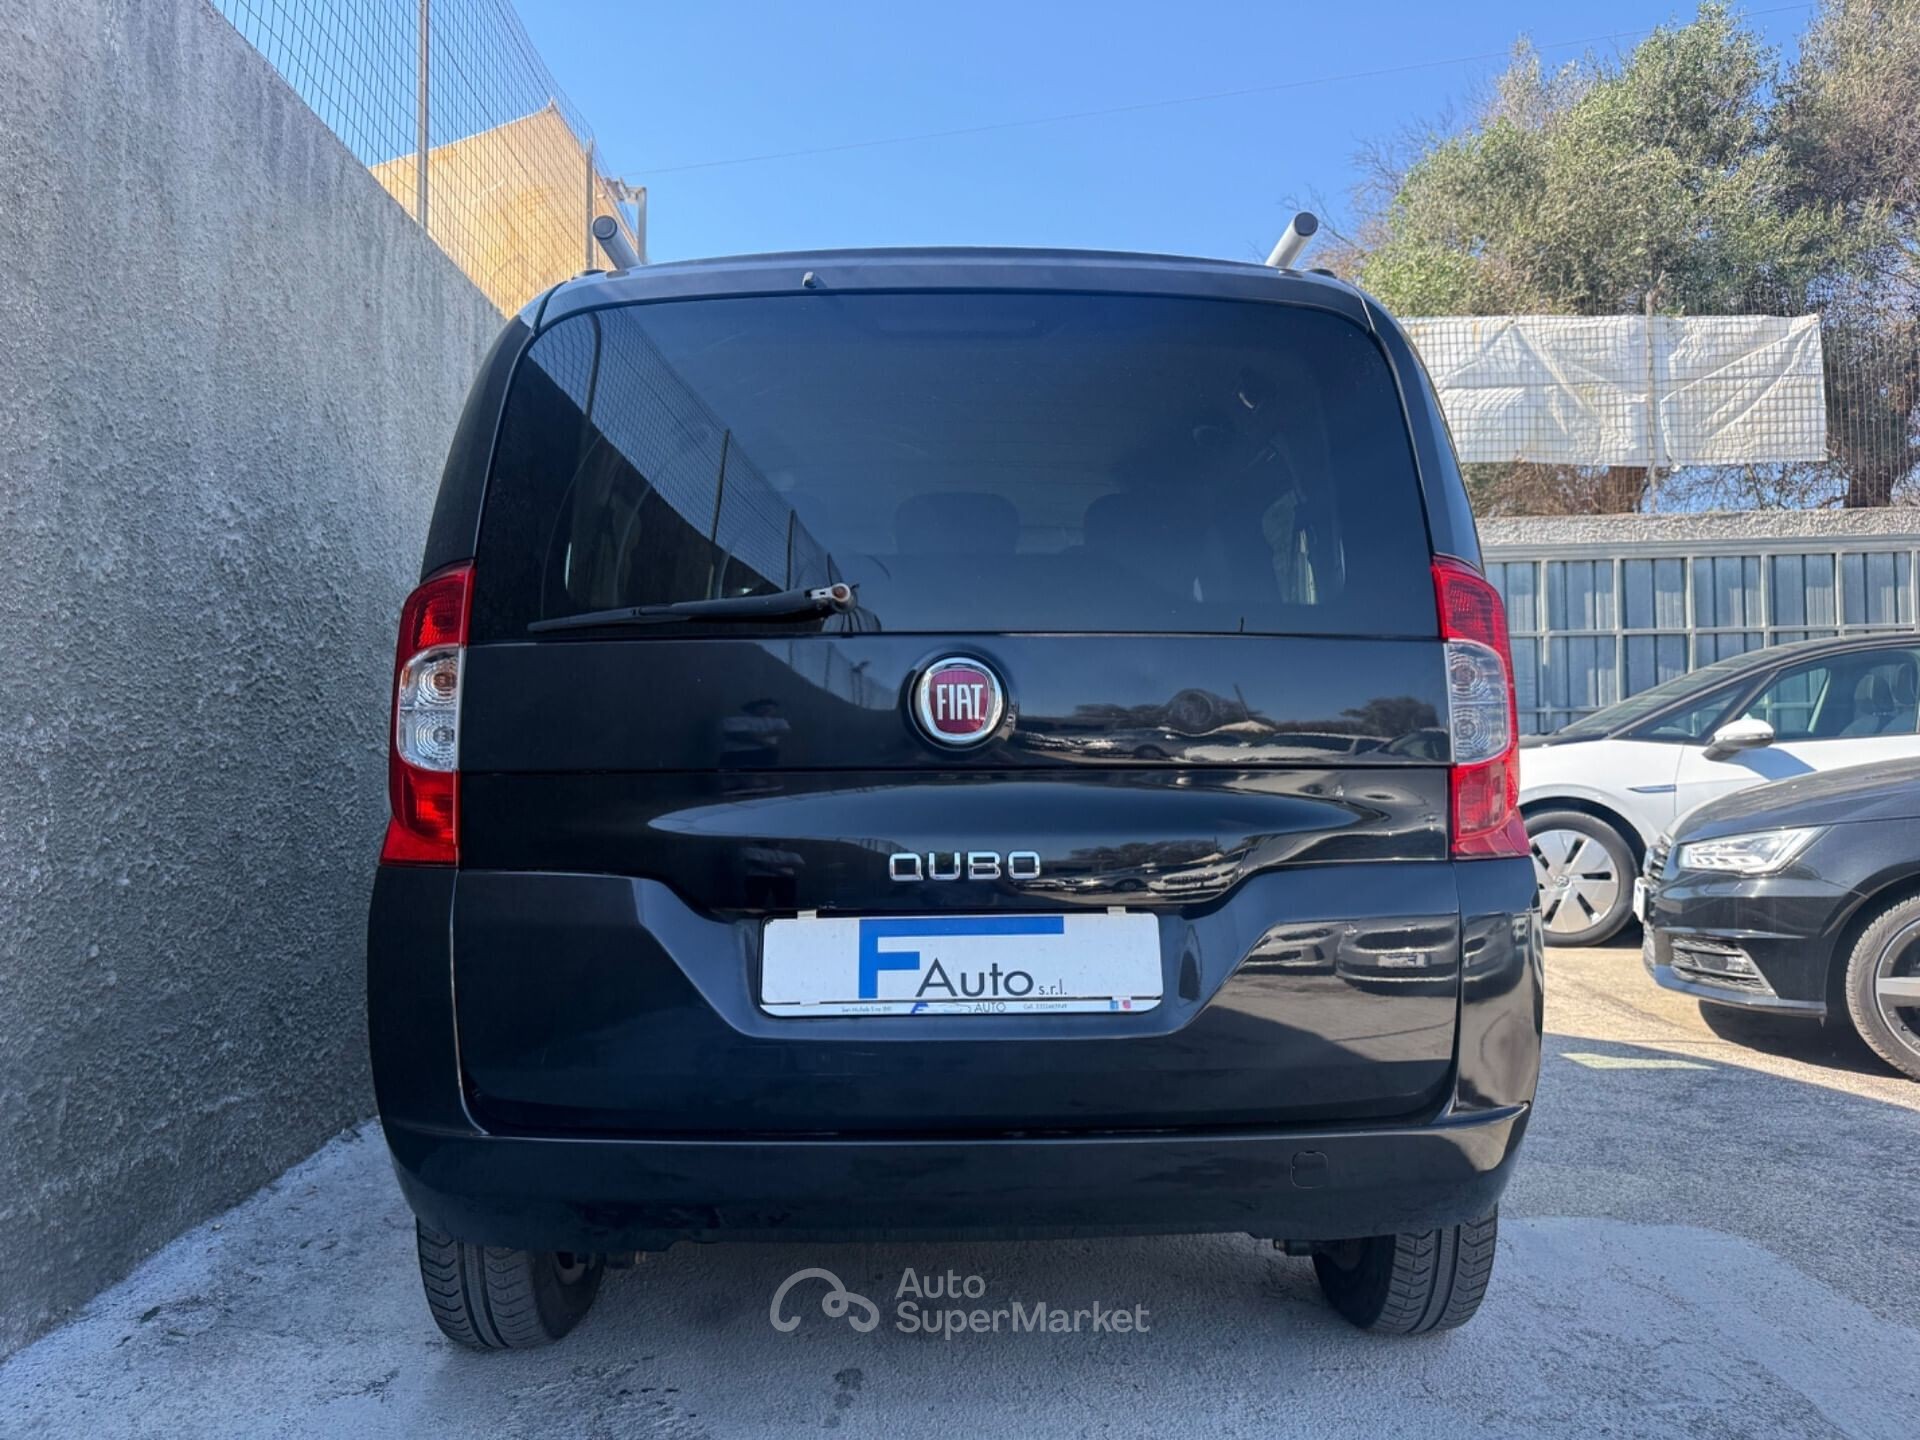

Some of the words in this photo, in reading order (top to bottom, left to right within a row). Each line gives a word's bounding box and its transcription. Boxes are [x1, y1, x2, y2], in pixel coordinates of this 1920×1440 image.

[936, 684, 984, 720] FIAT
[889, 851, 1041, 881] QUBO
[915, 957, 1034, 998] Auto
[1038, 979, 1068, 996] s.r.l.
[974, 1001, 1006, 1014] AUTO
